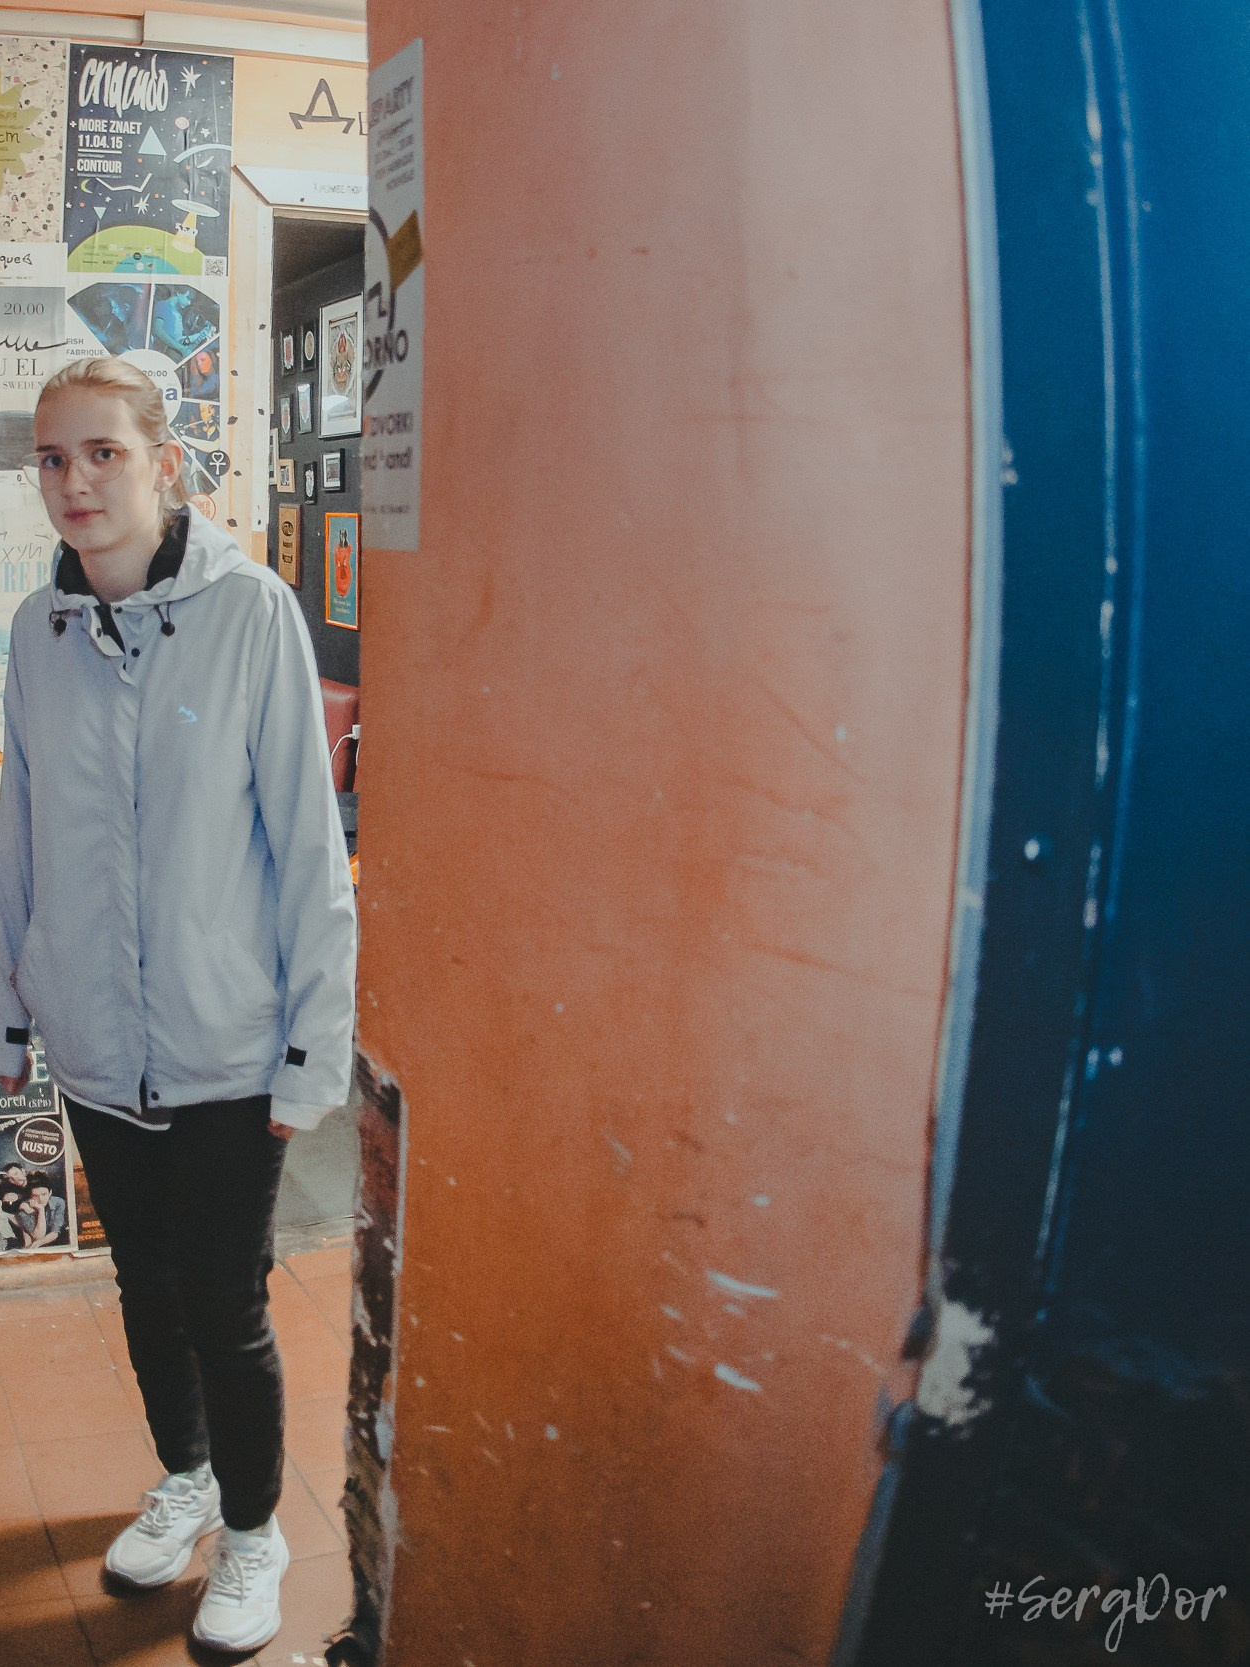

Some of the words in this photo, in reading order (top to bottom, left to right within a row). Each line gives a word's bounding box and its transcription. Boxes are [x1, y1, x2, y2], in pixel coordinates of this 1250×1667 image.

[78, 119, 108, 132] MORE
[109, 120, 143, 135] ZNAET
[78, 134, 123, 149] 11.04.15
[76, 159, 122, 173] CONTOUR
[3, 302, 45, 315] 20.00
[65, 348, 104, 356] FABRIQUE
[21, 1141, 58, 1156] KUSTO
